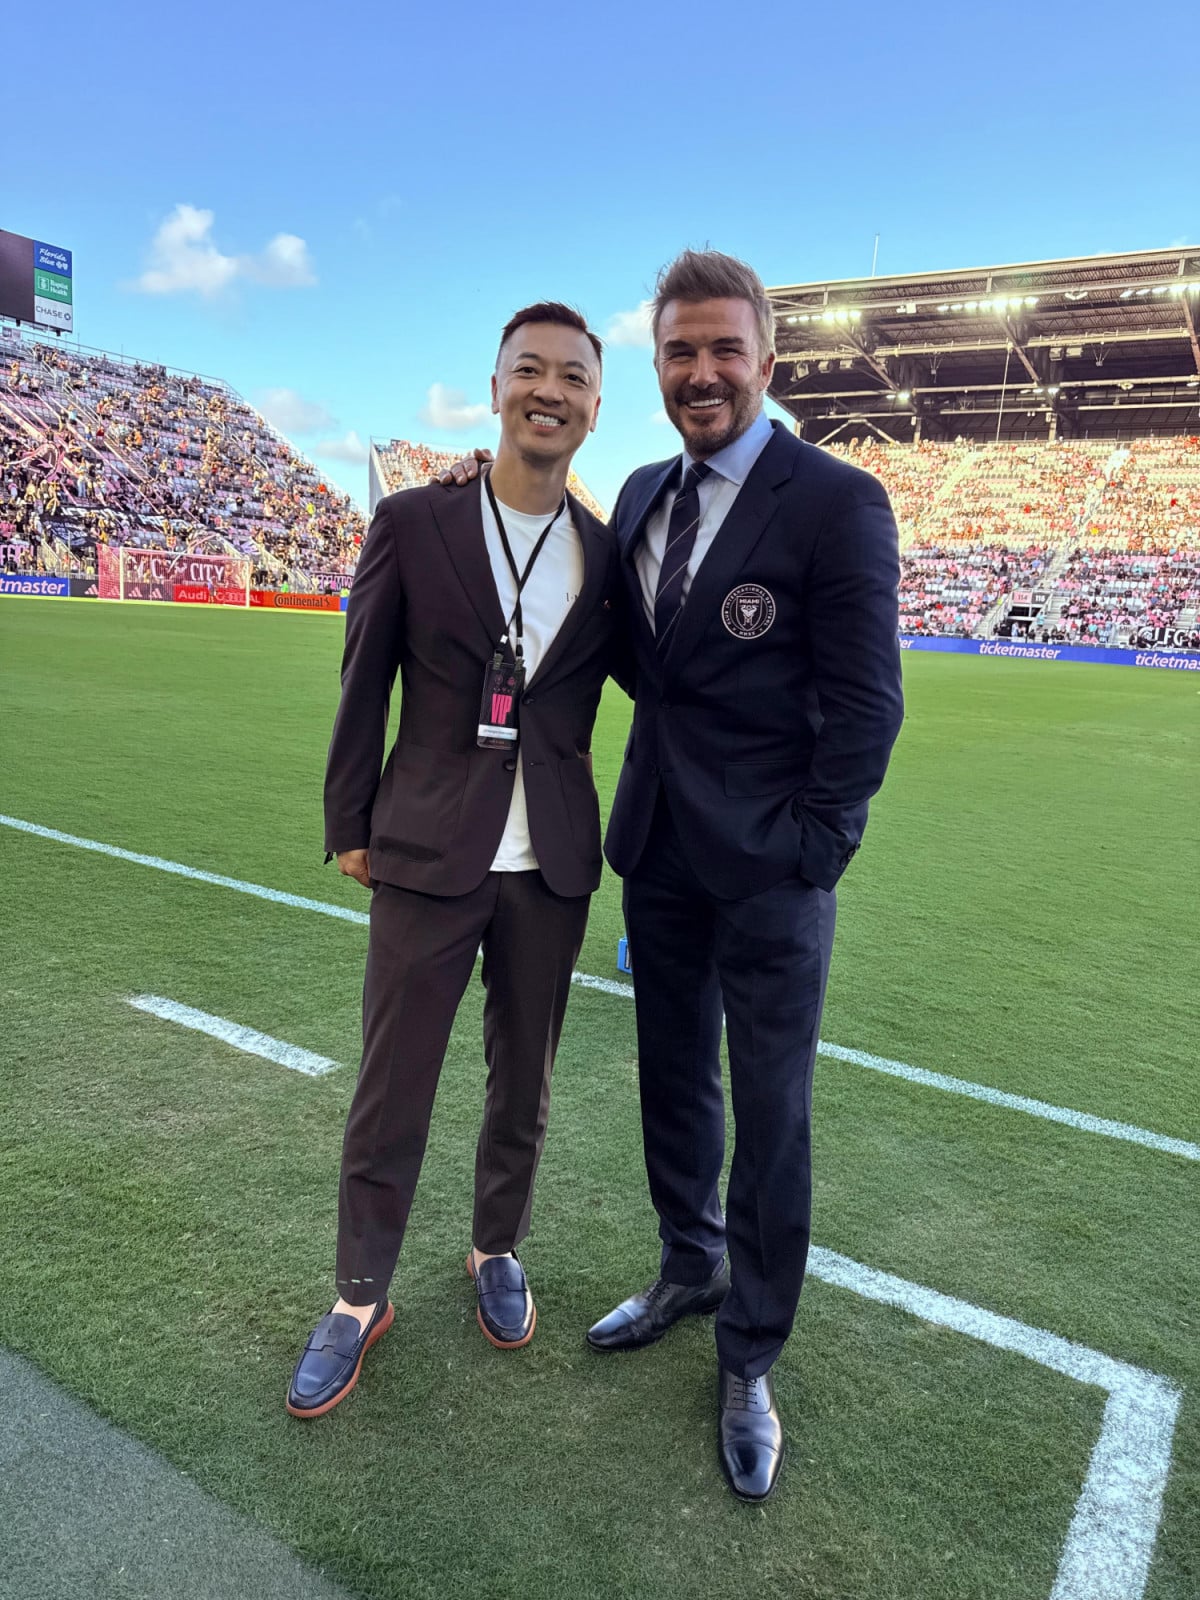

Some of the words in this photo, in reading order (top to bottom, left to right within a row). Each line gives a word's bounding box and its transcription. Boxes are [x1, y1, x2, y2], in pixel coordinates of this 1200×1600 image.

[36, 306, 63, 318] CHASE
[190, 562, 225, 582] CITY
[178, 590, 208, 601] Audi
[274, 593, 323, 608] Continental
[980, 642, 1061, 659] ticketmaster
